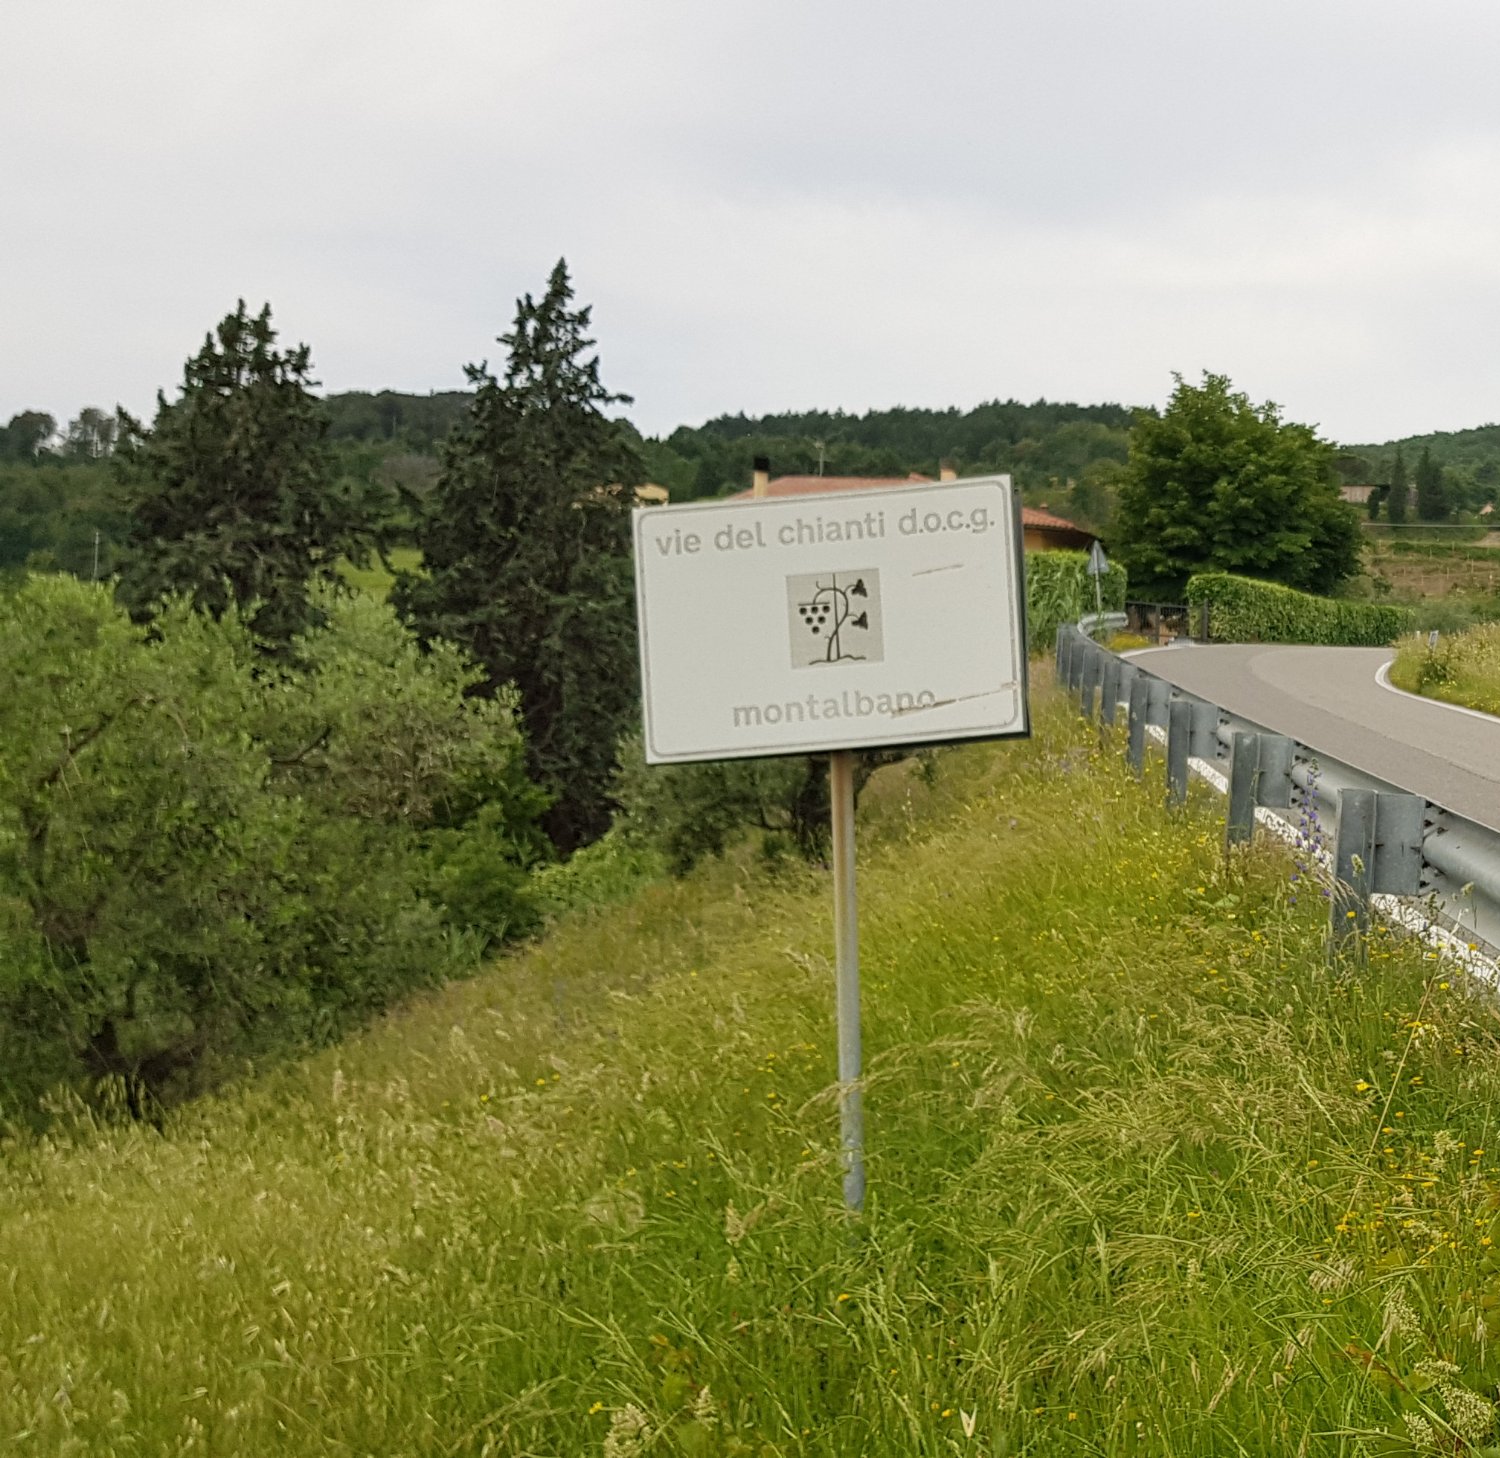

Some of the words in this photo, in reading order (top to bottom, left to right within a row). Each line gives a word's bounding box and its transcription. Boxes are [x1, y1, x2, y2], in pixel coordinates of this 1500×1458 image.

[655, 528, 702, 557] vie
[713, 520, 768, 552] del
[777, 511, 886, 546] chianti
[897, 507, 996, 536] d.o.c.g.
[733, 689, 936, 728] montalbano
